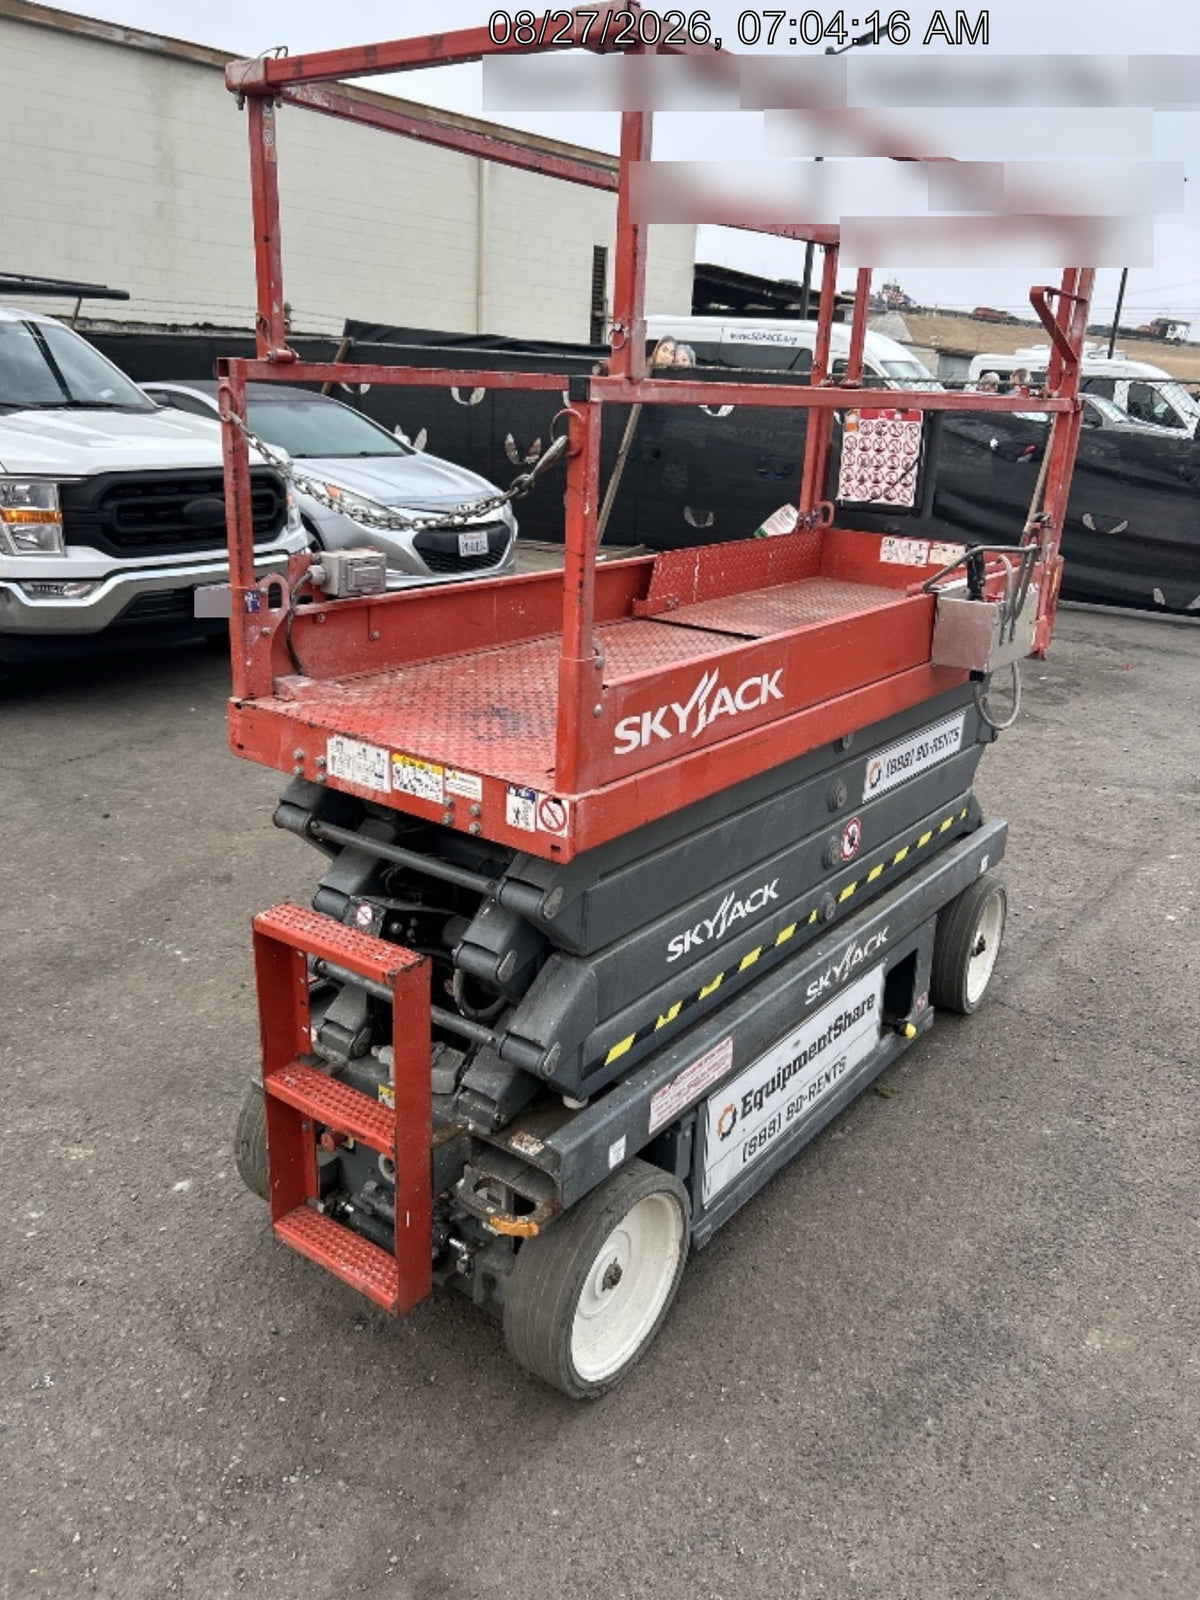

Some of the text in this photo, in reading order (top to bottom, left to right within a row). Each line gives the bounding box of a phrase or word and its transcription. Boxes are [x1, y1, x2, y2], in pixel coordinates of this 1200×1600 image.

[613, 667, 785, 755] SKYJACK
[666, 878, 780, 962] SKYJACK
[805, 926, 890, 1005] SKYJACK
[741, 993, 876, 1119] EquipmentShare
[742, 1112, 782, 1163] (888)
[786, 1056, 848, 1121] 80-RENTS
